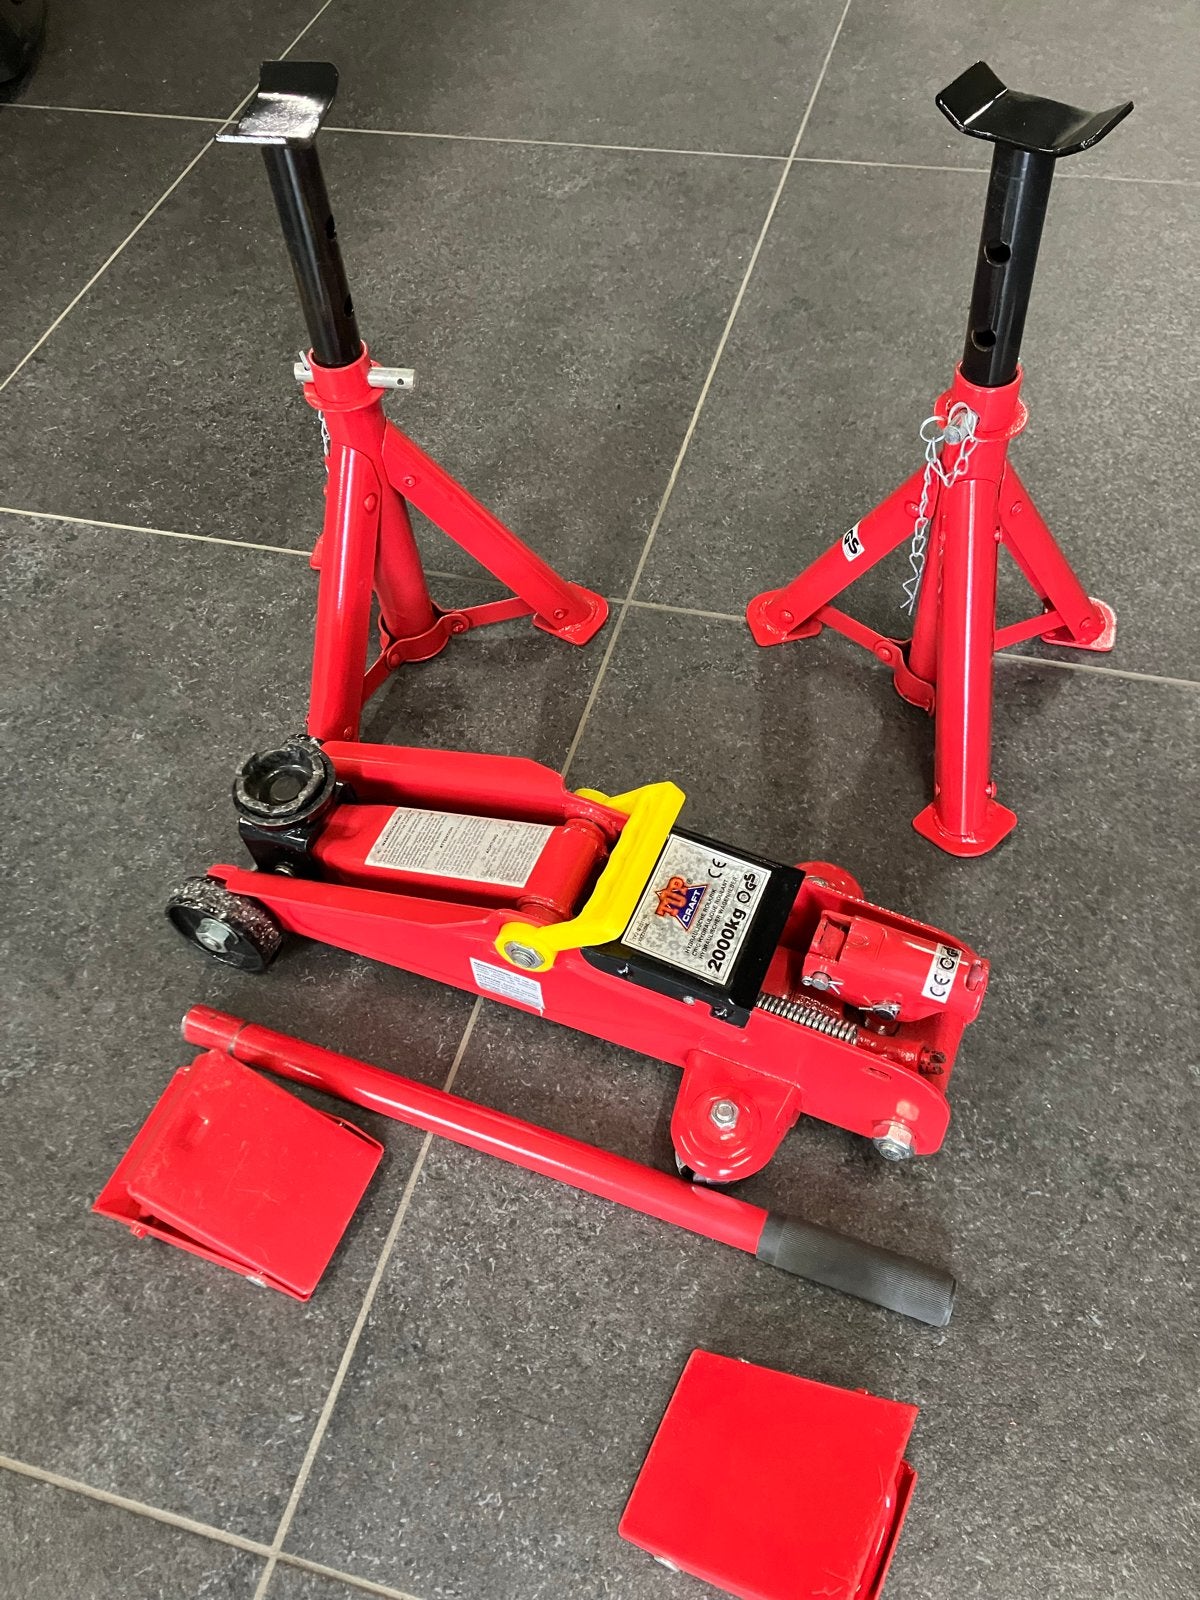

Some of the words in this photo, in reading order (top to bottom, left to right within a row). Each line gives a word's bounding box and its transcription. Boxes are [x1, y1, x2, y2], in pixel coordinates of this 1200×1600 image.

[708, 858, 727, 878] CE
[682, 889, 701, 923] CRAFT
[698, 905, 718, 943] HYDRAULIQUE
[715, 879, 729, 906] ROULANT
[699, 914, 722, 959] HYDRAULISCHER
[719, 876, 738, 915] WAGENHEBER
[685, 912, 706, 954] HYDRAULISCHE
[708, 908, 746, 972] 2000kg
[930, 974, 950, 996] CE
